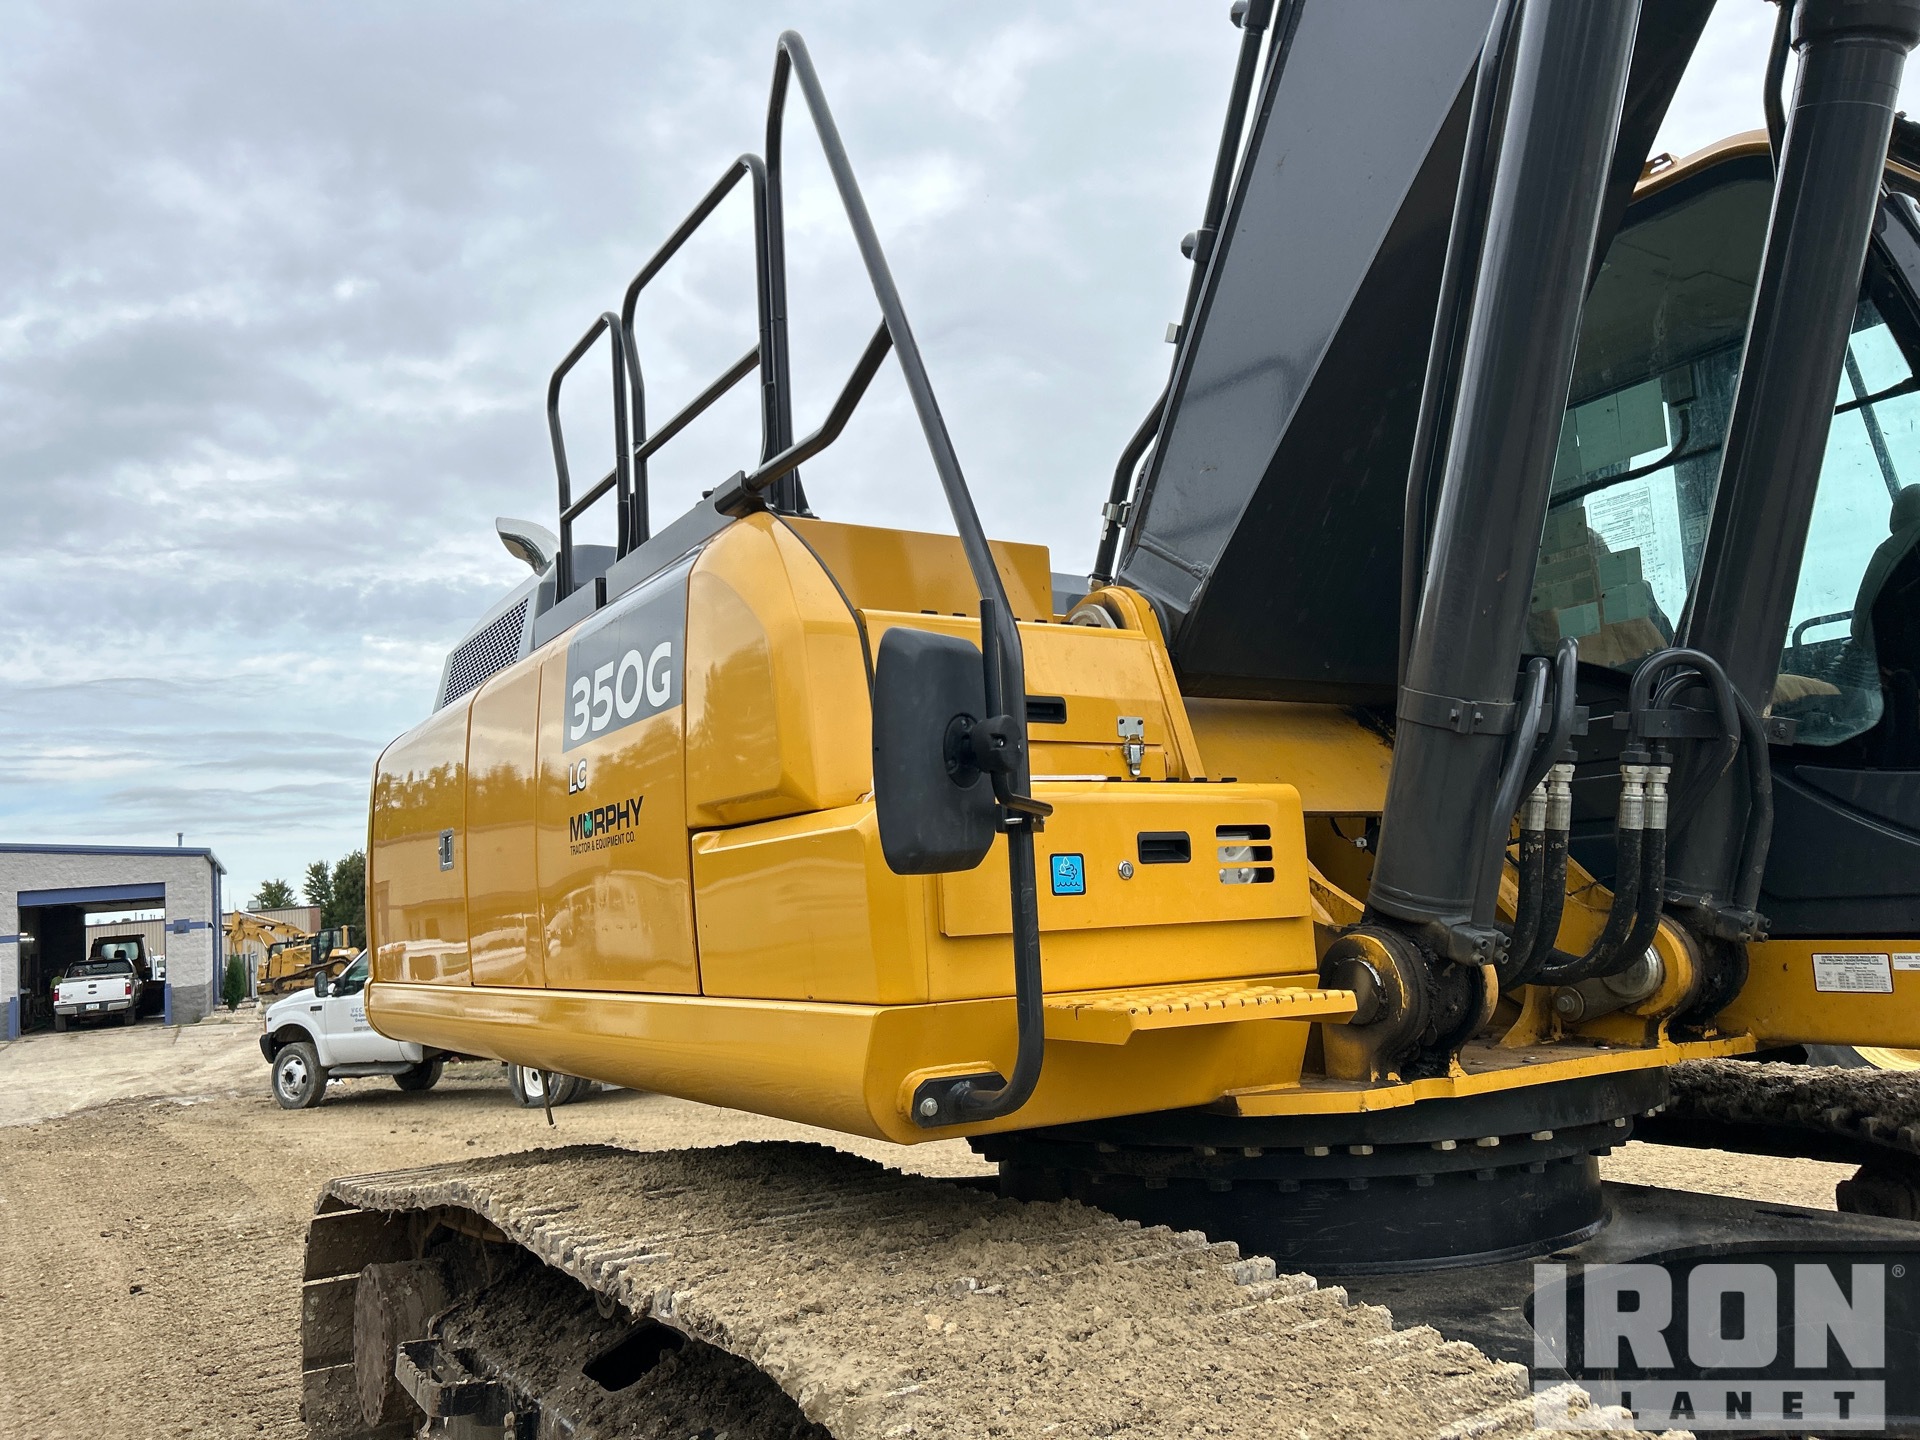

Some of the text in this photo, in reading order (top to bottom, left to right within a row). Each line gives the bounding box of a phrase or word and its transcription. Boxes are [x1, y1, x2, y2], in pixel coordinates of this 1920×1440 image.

[570, 641, 672, 742] 350G
[569, 758, 587, 795] LC
[570, 796, 644, 843] MURPHY
[570, 841, 591, 856] TRACTOR
[595, 832, 625, 850] EQUIPMENT
[625, 831, 636, 844] CO.
